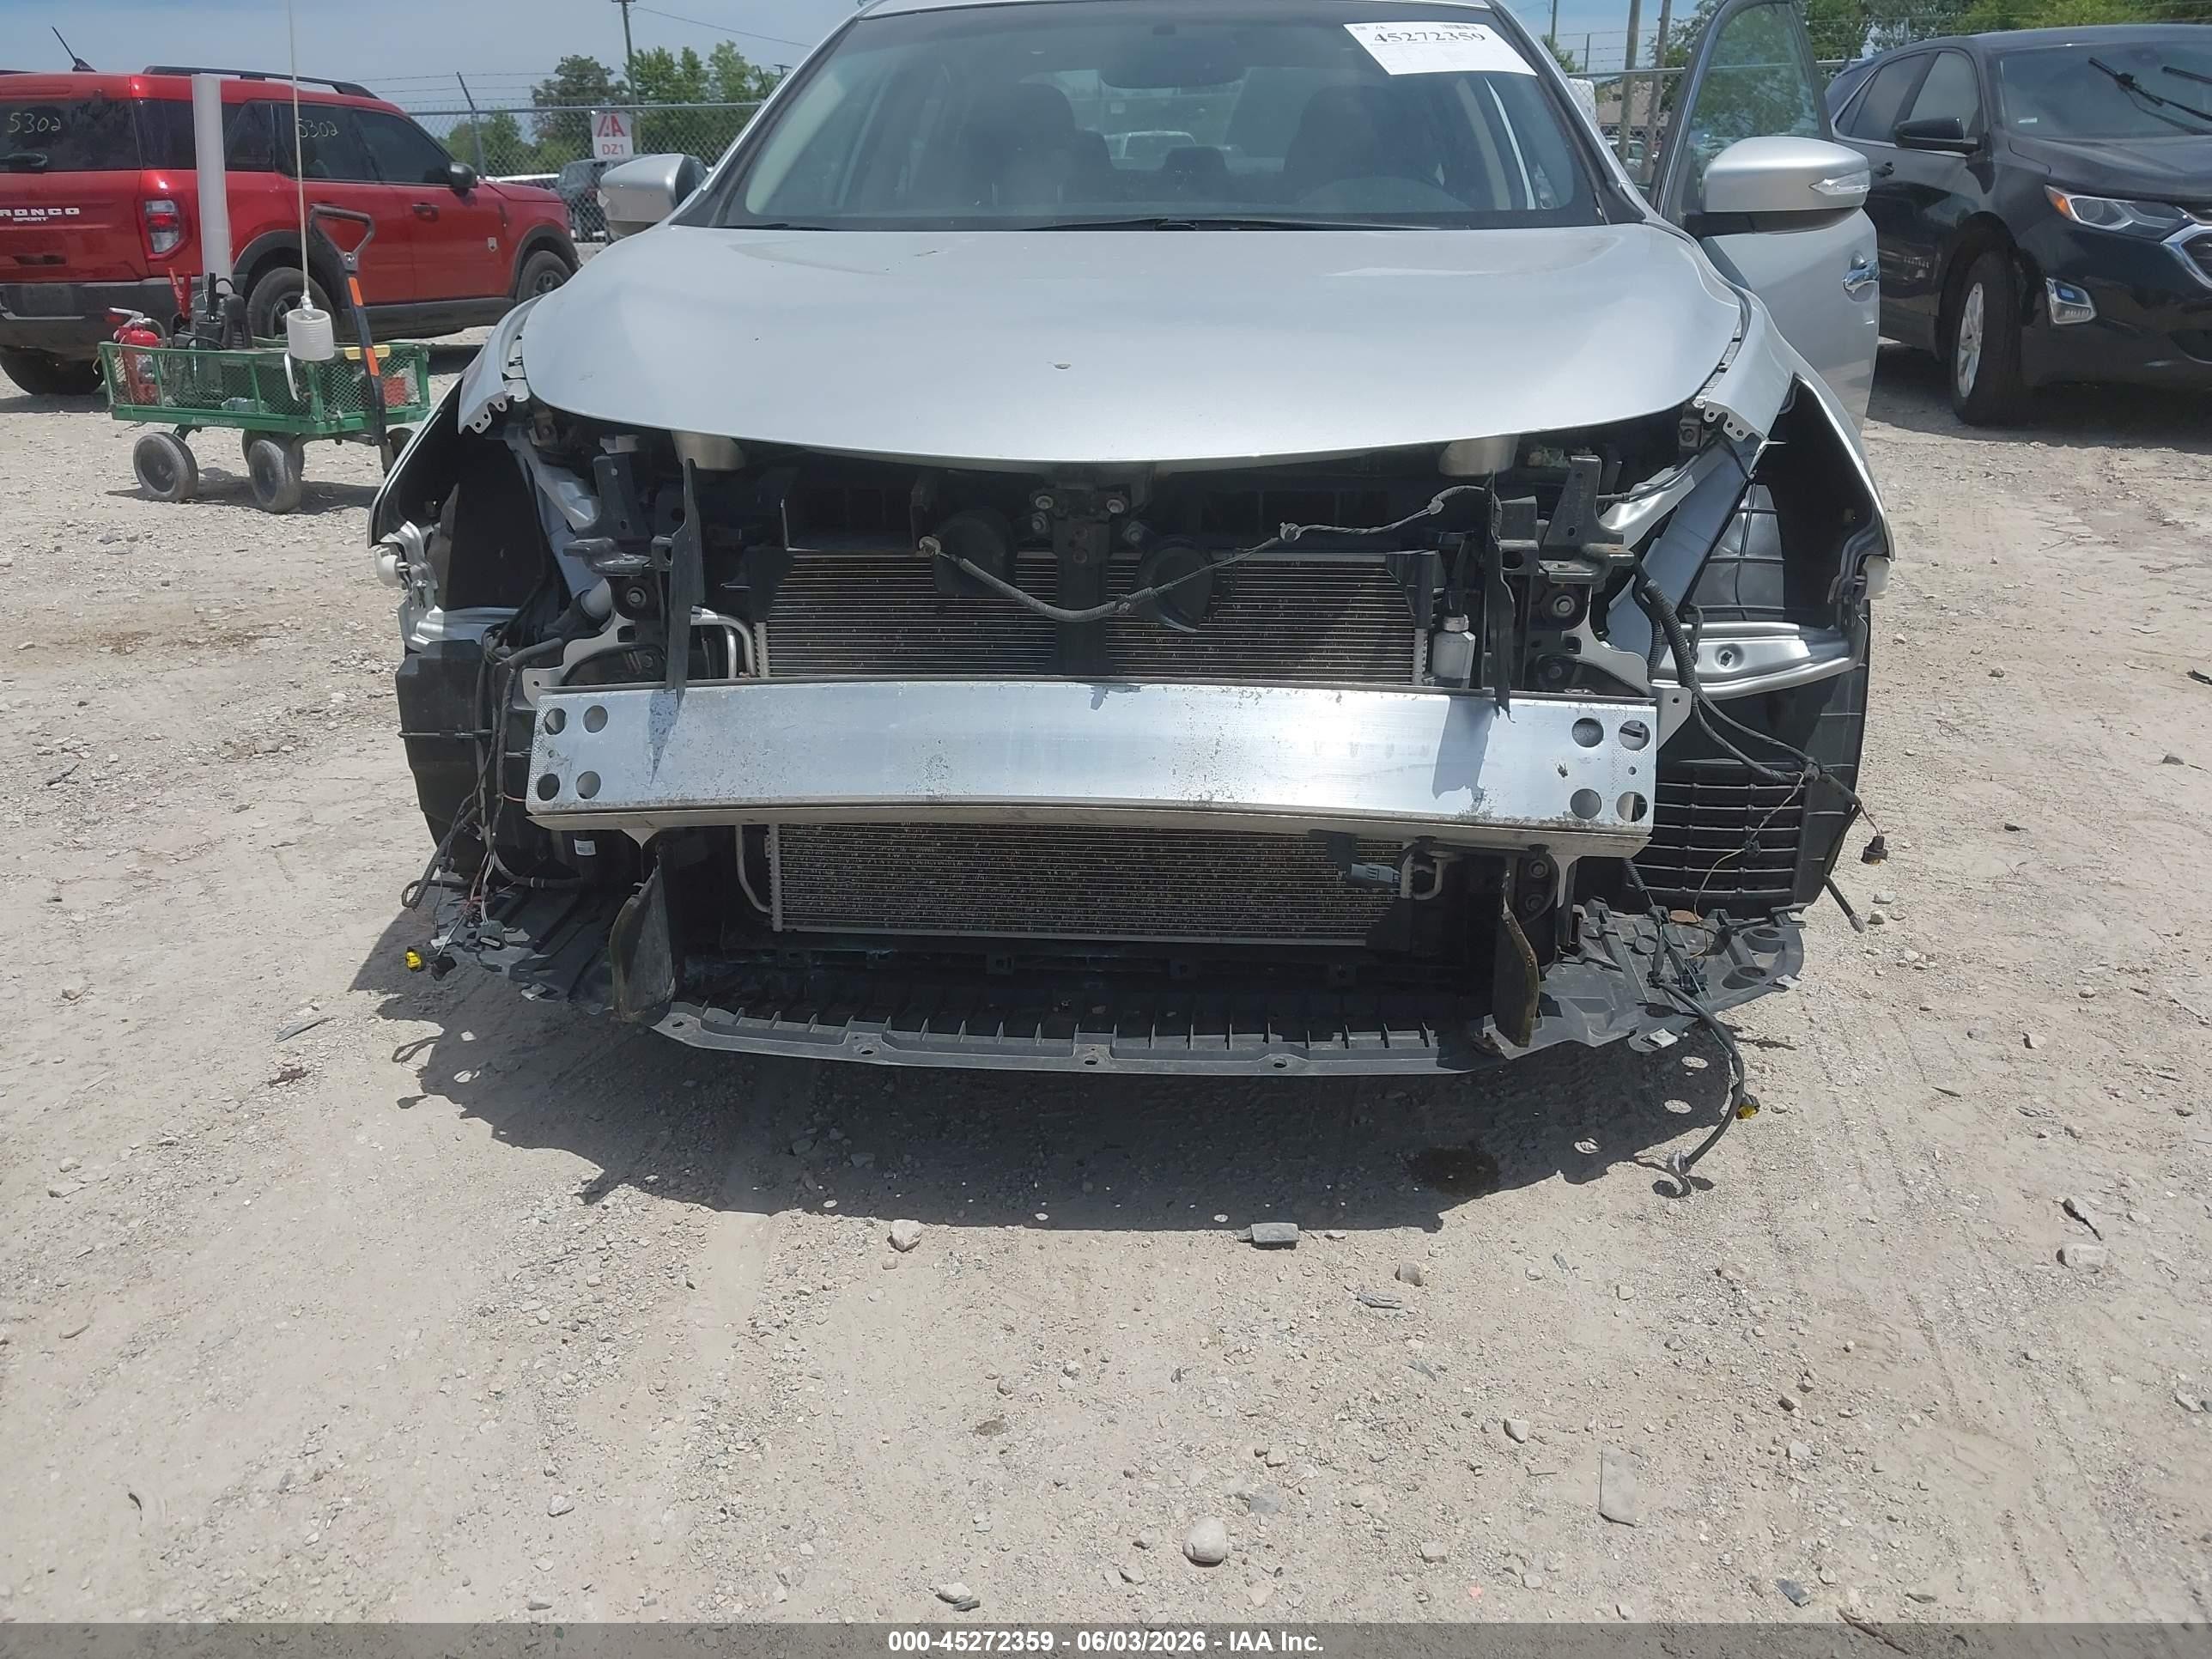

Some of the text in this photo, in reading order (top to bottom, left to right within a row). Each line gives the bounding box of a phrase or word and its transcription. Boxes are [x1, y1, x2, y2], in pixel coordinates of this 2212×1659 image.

[1374, 32, 1486, 42] 45272359
[7, 112, 62, 134] 5302
[602, 143, 624, 155] DZ1
[0, 208, 80, 216] RONCO
